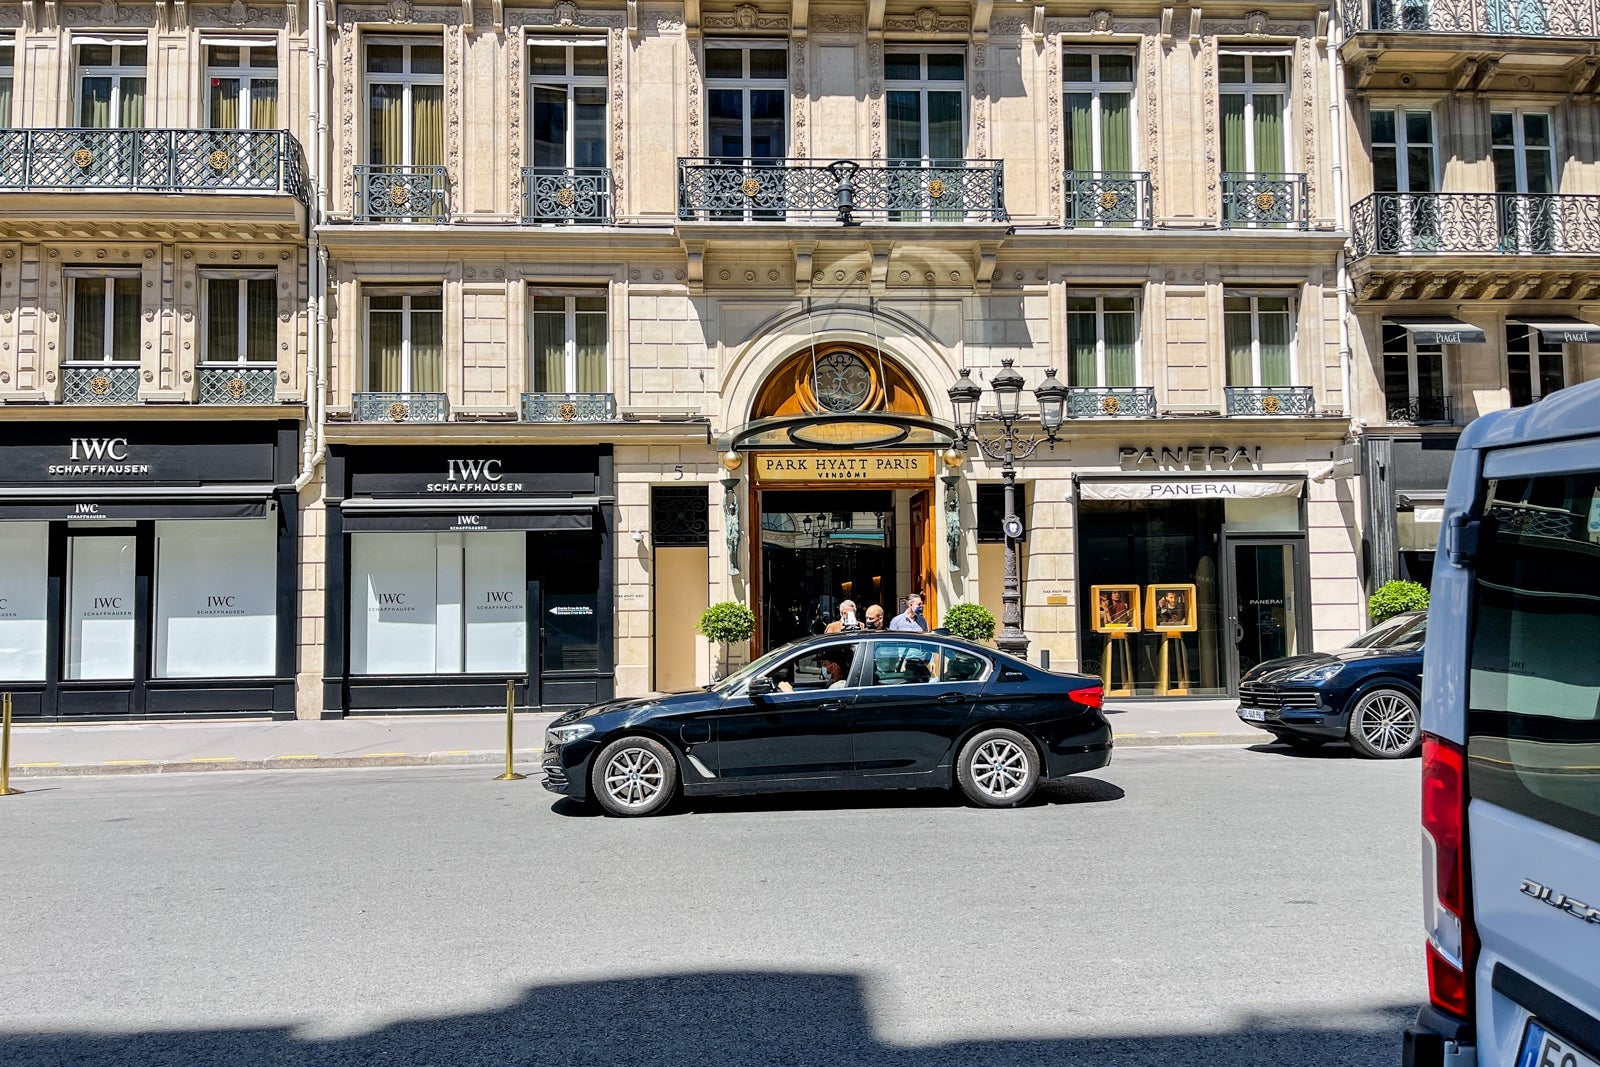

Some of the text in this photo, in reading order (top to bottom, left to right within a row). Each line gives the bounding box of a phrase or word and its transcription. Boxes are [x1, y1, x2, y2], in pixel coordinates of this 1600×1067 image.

[1436, 332, 1462, 343] PIAGET
[1564, 332, 1589, 343] PIAGET
[70, 438, 128, 460] IWC
[1118, 446, 1262, 464] PANERAI
[48, 465, 148, 473] SCHAFFHAUSEN
[766, 458, 918, 470] PARK HYATT PARIS
[447, 459, 502, 481] IWC
[674, 465, 683, 480] 5
[818, 470, 867, 478] VENDÔME
[426, 483, 522, 491] SCHAFFHAUSEN
[1150, 484, 1236, 495] PANERAI
[75, 503, 99, 513] IWC
[457, 515, 480, 525] IWC
[207, 596, 235, 607] IWC
[378, 593, 406, 604] IWC
[486, 591, 513, 602] IWC
[94, 597, 122, 608] IWC
